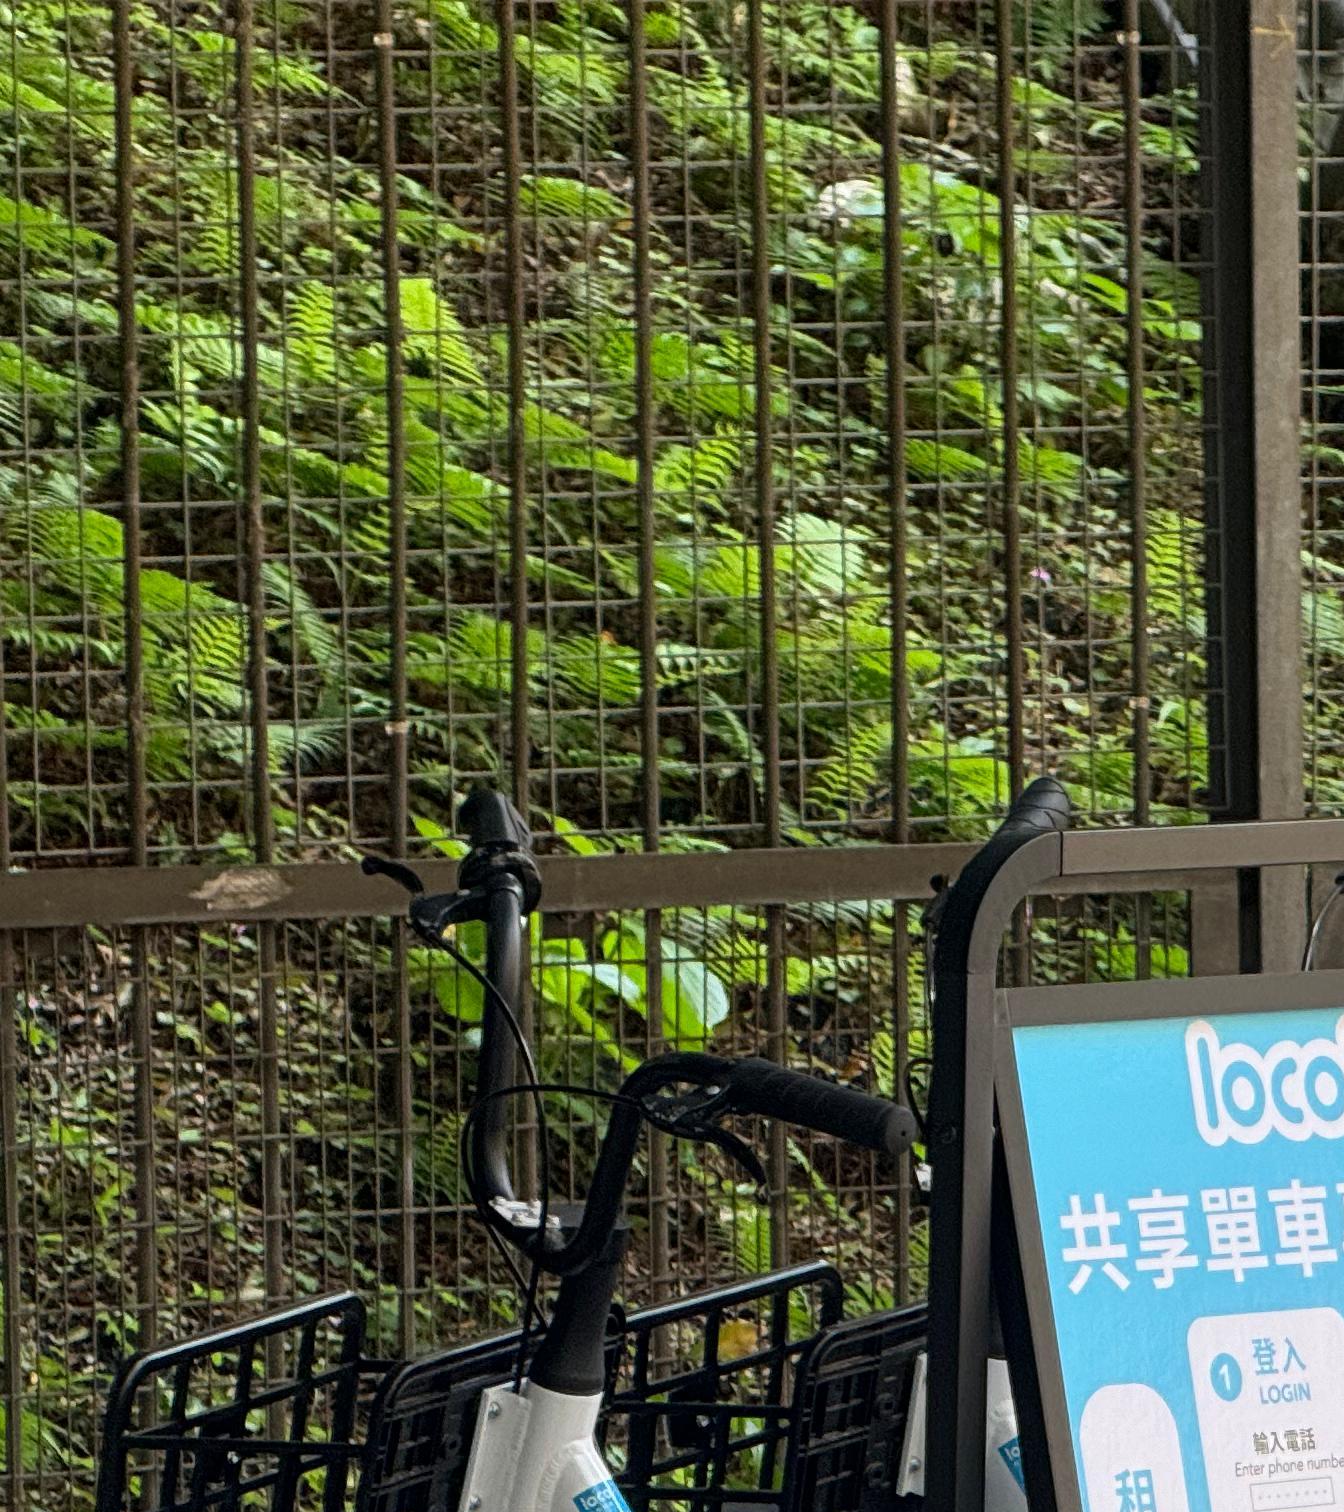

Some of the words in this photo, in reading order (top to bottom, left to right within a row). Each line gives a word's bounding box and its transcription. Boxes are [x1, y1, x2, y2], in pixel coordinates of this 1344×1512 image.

[1250, 1335, 1307, 1376] 登入
[1258, 1381, 1312, 1405] LOGIN
[1251, 1426, 1317, 1456] 輸入電話
[1233, 1460, 1265, 1478] Enter
[1267, 1455, 1304, 1479] phone
